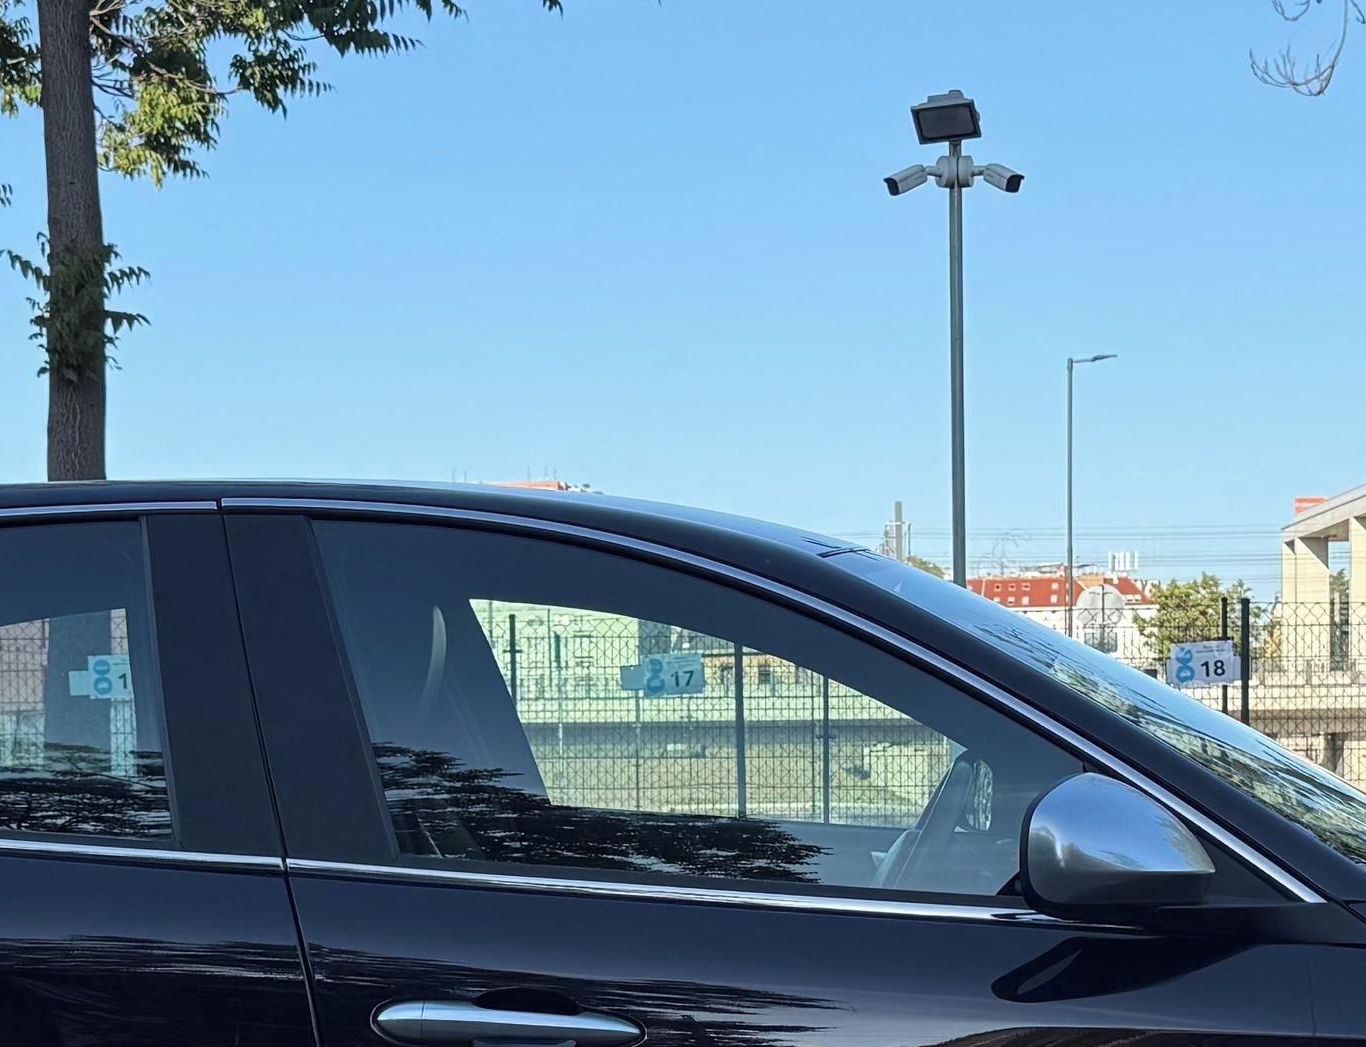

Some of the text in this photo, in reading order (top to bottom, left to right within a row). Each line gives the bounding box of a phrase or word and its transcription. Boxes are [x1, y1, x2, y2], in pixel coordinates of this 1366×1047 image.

[1200, 660, 1226, 677] 18
[118, 673, 128, 689] 1
[670, 670, 695, 687] 17
